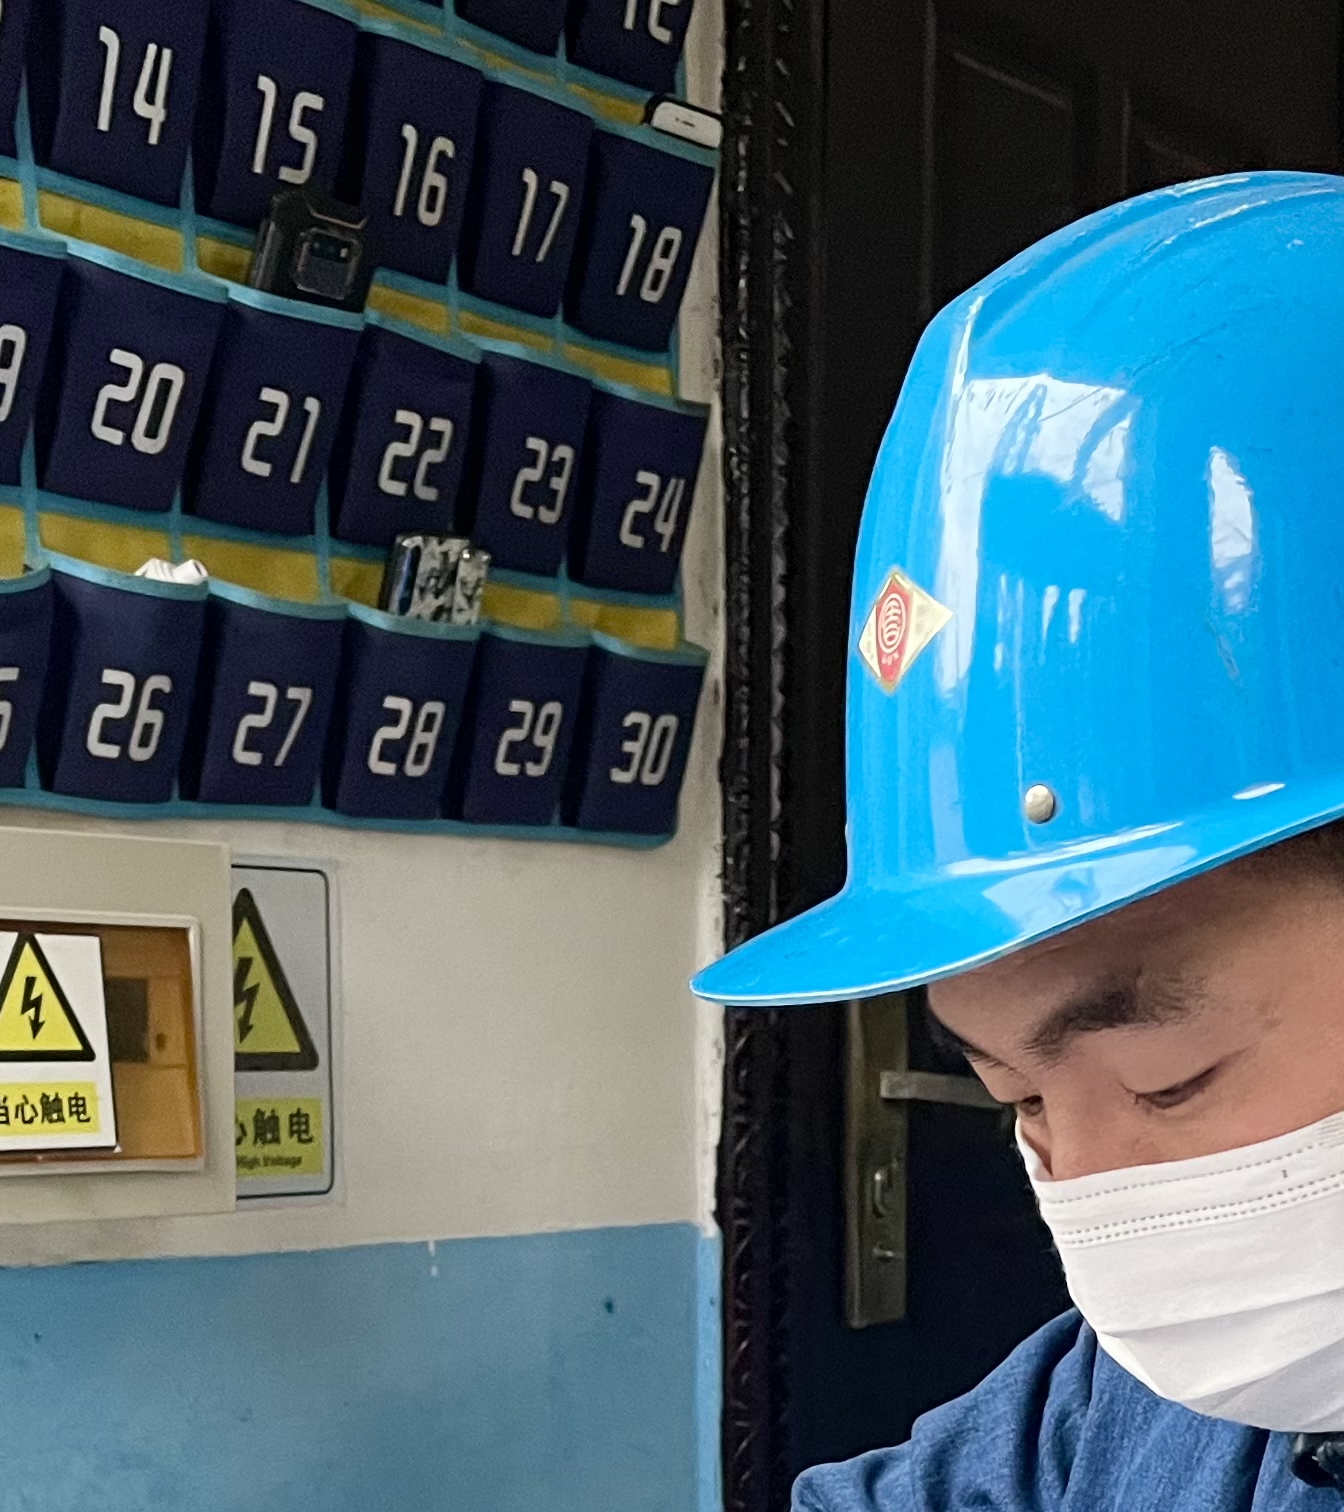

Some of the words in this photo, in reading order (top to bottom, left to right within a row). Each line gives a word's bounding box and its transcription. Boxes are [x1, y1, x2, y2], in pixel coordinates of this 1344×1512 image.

[98, 26, 171, 145] 14
[253, 75, 324, 184] 15
[394, 124, 455, 227] 16
[513, 168, 570, 263] 17
[617, 213, 683, 303] 18
[91, 348, 185, 455] 20
[241, 387, 321, 485] 21
[379, 409, 454, 501] 22
[510, 436, 576, 524] 23
[619, 470, 686, 552] 24
[87, 669, 173, 762] 26
[233, 681, 313, 767] 27
[368, 696, 447, 778] 28
[495, 700, 564, 777] 29
[610, 712, 680, 786] 30
